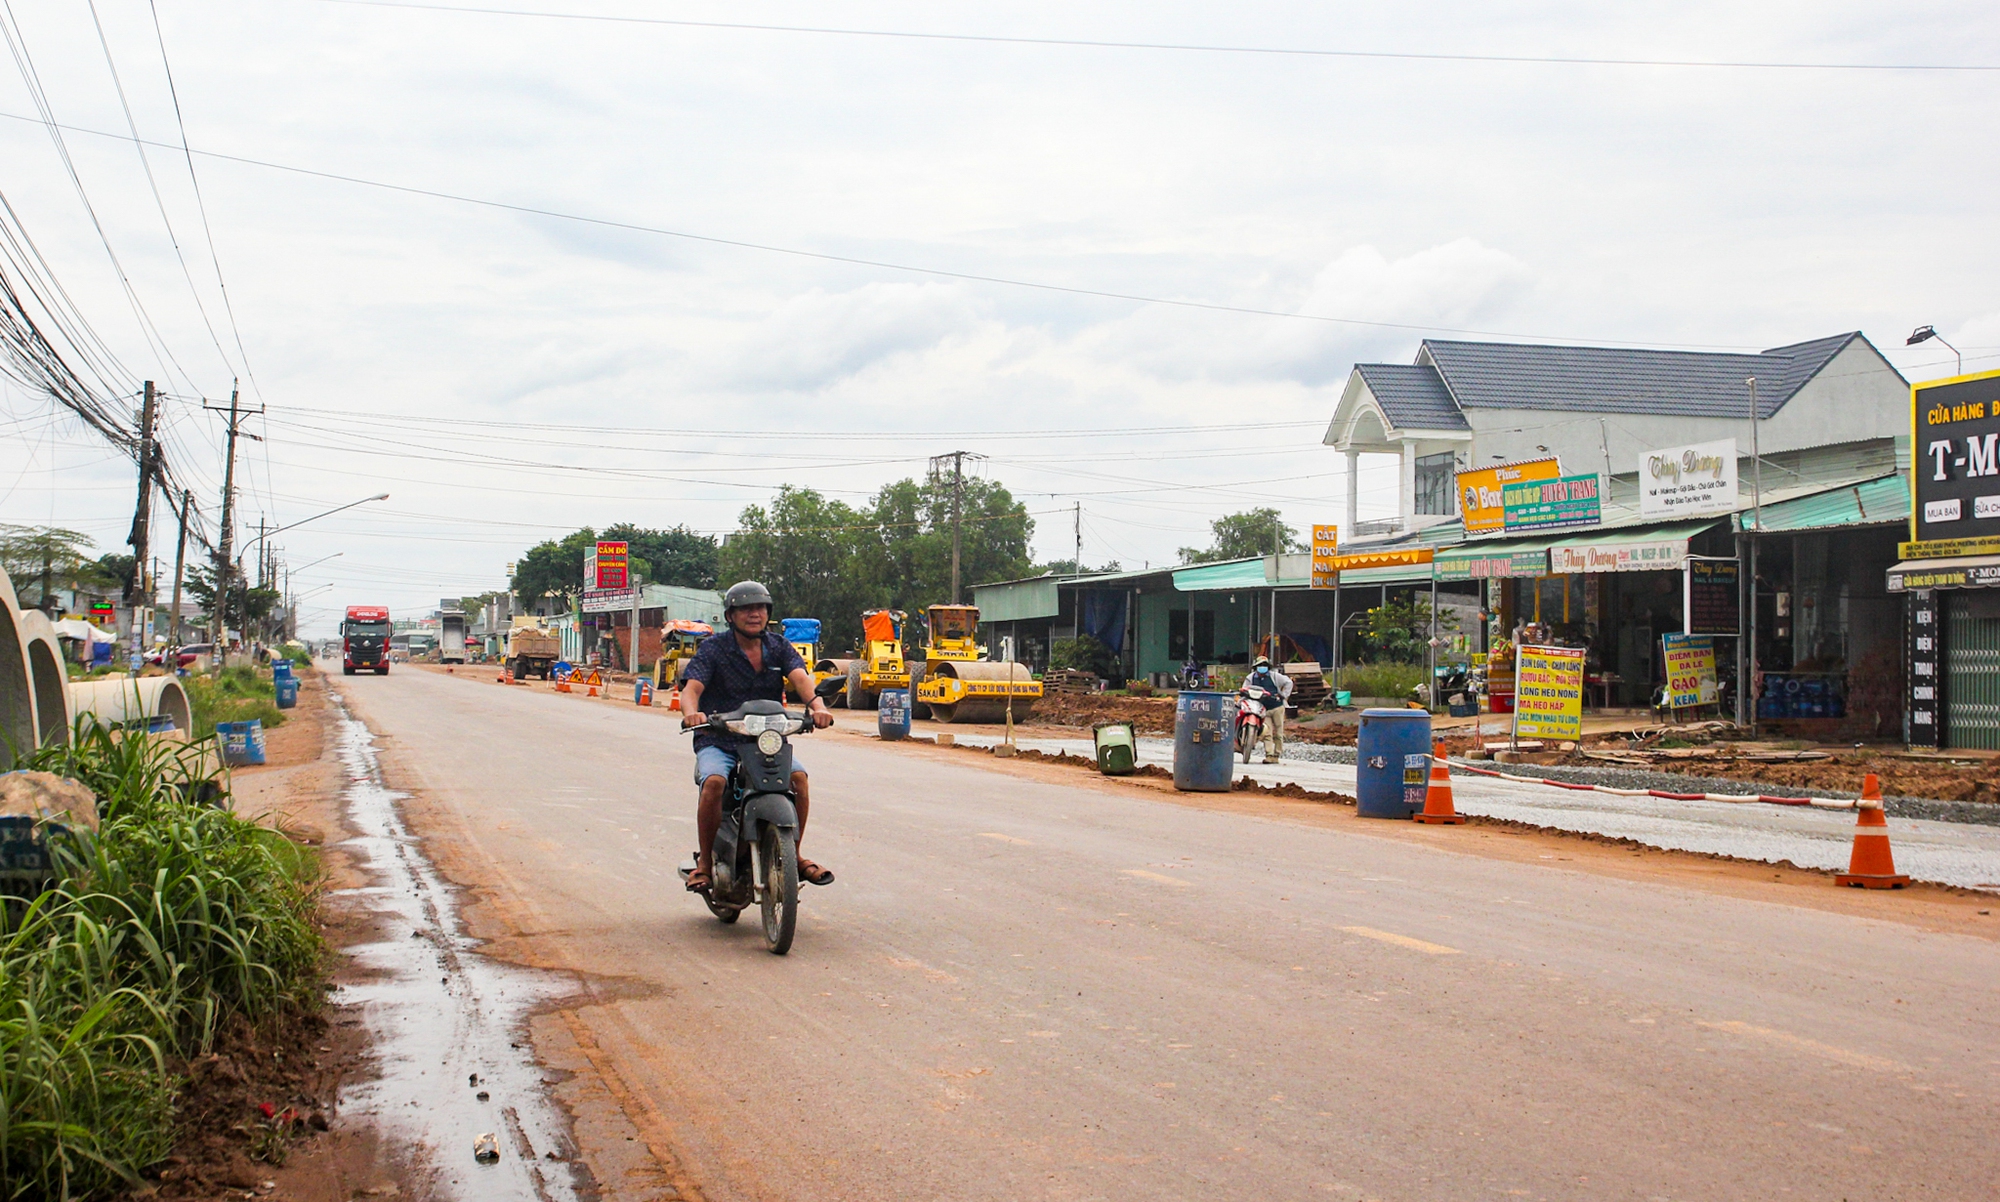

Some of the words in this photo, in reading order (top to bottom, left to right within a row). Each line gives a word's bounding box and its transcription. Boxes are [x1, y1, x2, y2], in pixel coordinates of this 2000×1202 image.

[1928, 403, 1950, 425] CỬA
[1953, 401, 1984, 422] HÀNG
[1928, 433, 2000, 481] T-M
[1568, 478, 1596, 500] TRANG
[1927, 508, 1943, 518] MUA
[1944, 506, 1958, 516] BÁN
[1316, 526, 1335, 540] CẮT
[1316, 544, 1335, 556] TÓC
[1314, 563, 1333, 572] NA
[1914, 662, 1933, 680] THOẠI
[1672, 676, 1698, 694] GẠO
[918, 688, 938, 698] SAKAI
[1541, 688, 1555, 697] HEO
[1534, 701, 1547, 709] HEO
[1914, 707, 1932, 724] HÀNG
